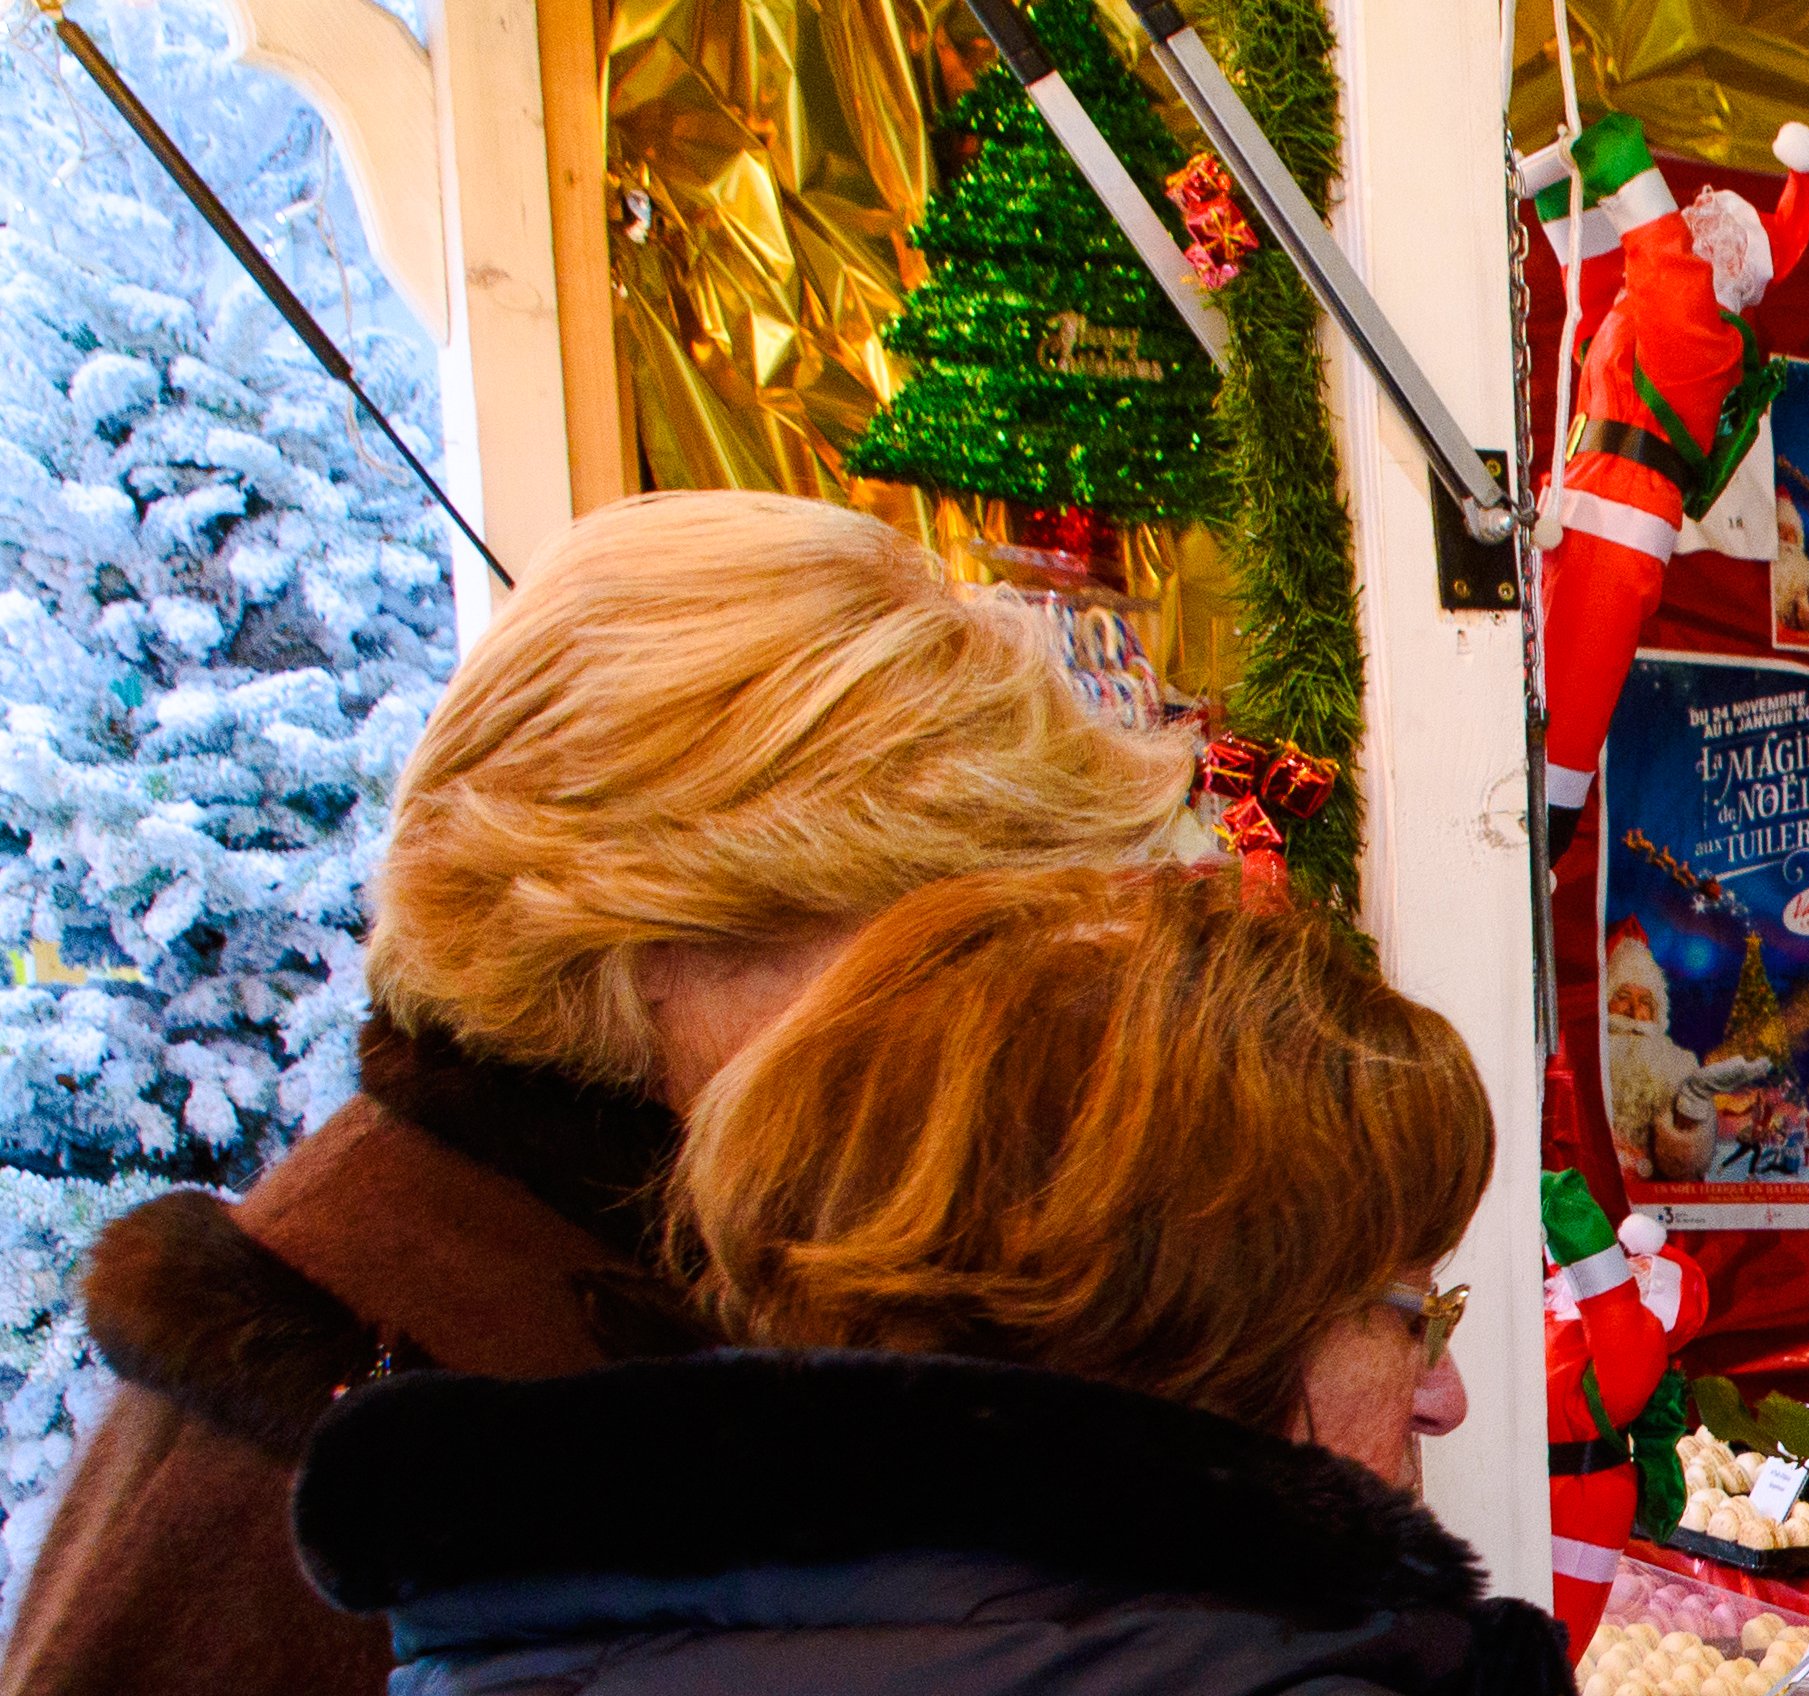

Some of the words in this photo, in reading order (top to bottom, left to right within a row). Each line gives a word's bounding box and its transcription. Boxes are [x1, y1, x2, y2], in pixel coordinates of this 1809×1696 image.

[1688, 707, 1709, 727] DU
[1732, 690, 1806, 717] NOVEMBRE
[1703, 722, 1722, 739] AU
[1736, 708, 1794, 734] JANVIER
[1718, 805, 1738, 824] de
[1695, 839, 1723, 857] aux
